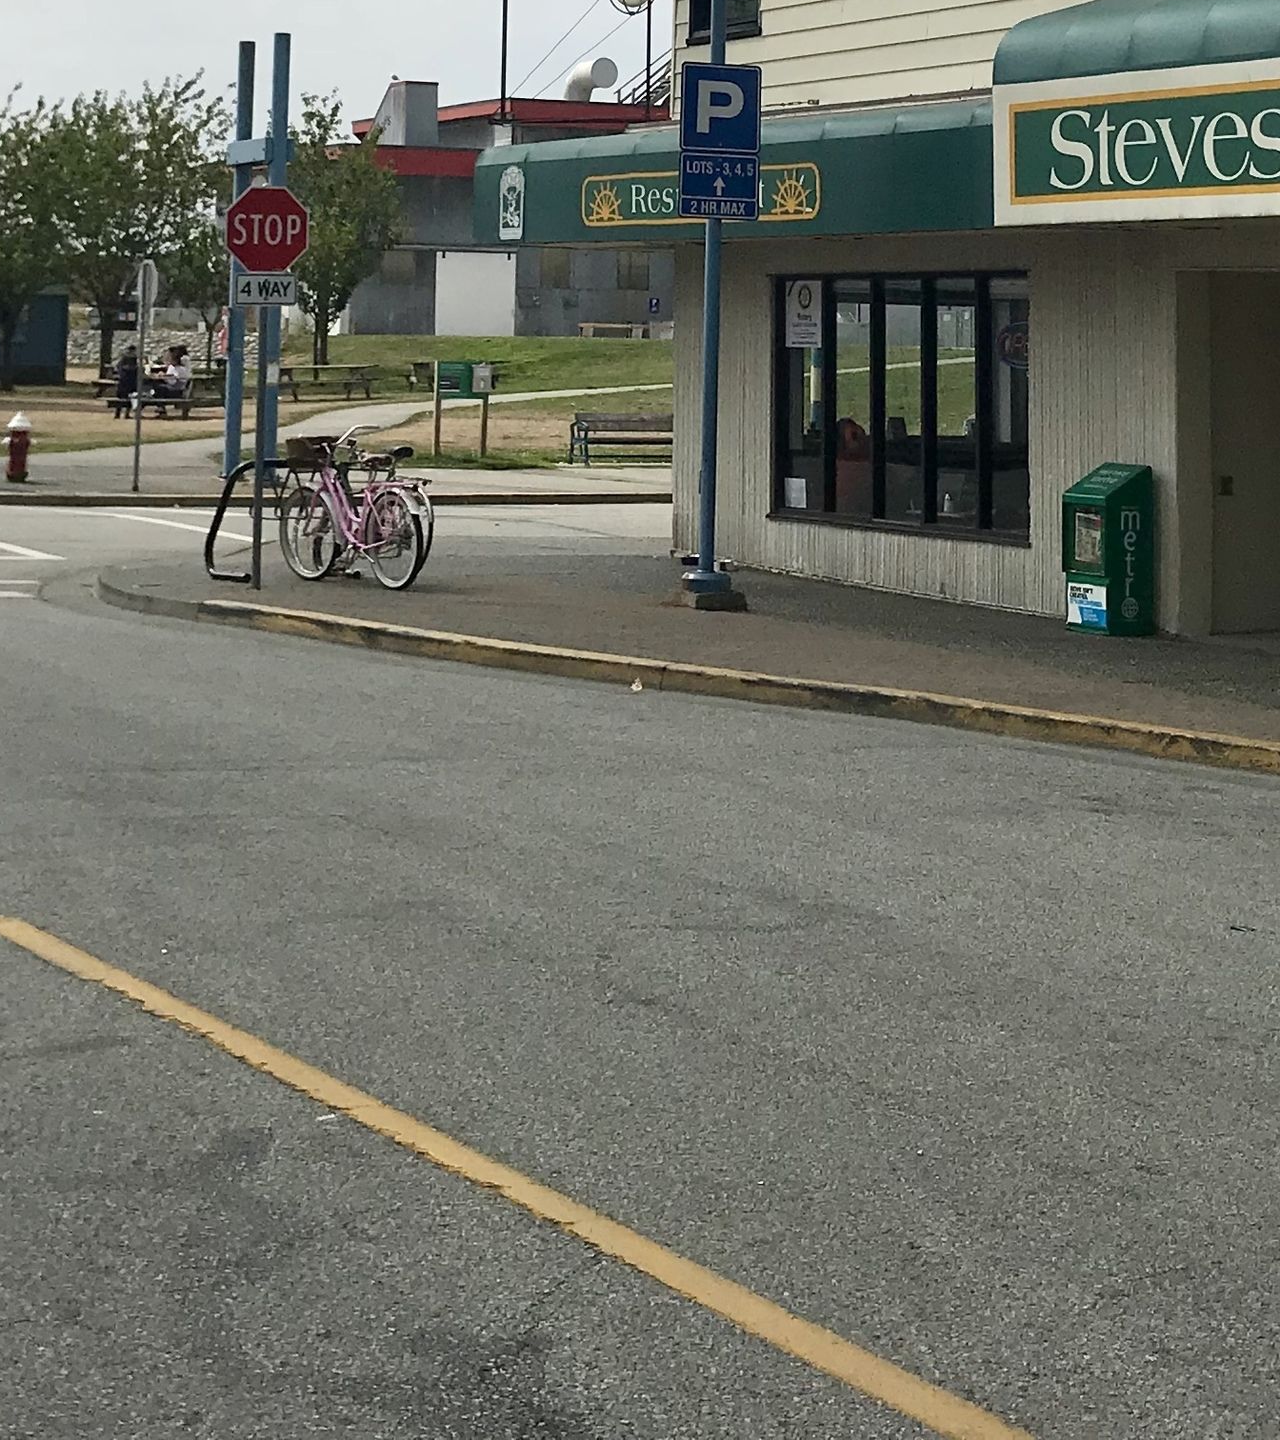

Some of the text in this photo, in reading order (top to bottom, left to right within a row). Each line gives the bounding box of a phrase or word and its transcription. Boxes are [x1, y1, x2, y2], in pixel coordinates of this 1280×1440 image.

[696, 79, 744, 134] P
[686, 160, 713, 174] LOTS
[747, 163, 754, 176] 5
[690, 200, 746, 215] 2 HR MAX
[232, 214, 301, 245] STOP
[240, 281, 292, 297] 4 WAY
